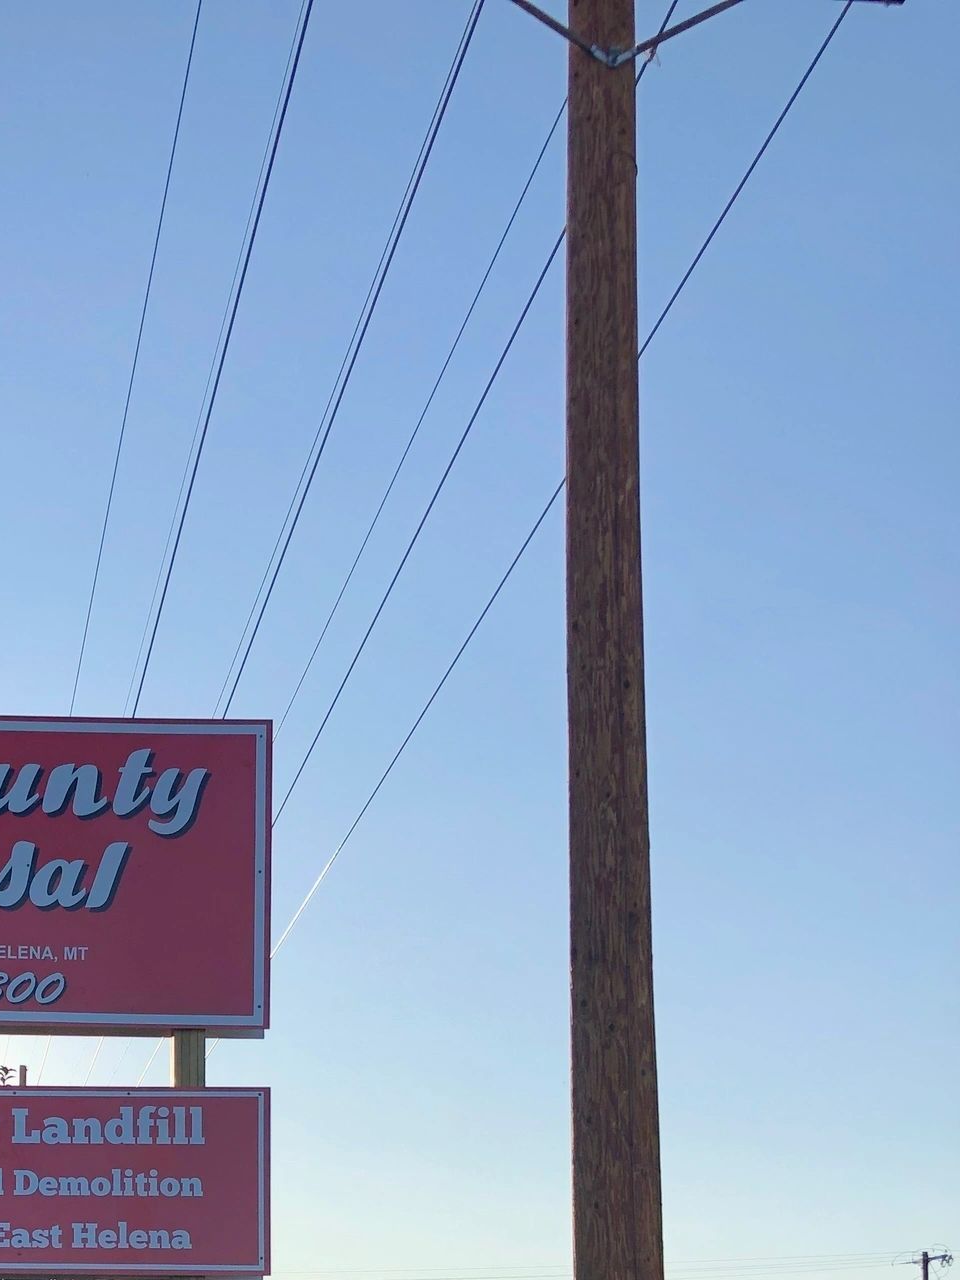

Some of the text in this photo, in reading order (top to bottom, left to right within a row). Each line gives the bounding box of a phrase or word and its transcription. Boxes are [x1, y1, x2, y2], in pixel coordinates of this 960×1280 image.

[63, 944, 88, 961] MT
[12, 1106, 205, 1146] Landfill
[14, 1169, 203, 1198] Demolition
[72, 1222, 192, 1250] Helena
